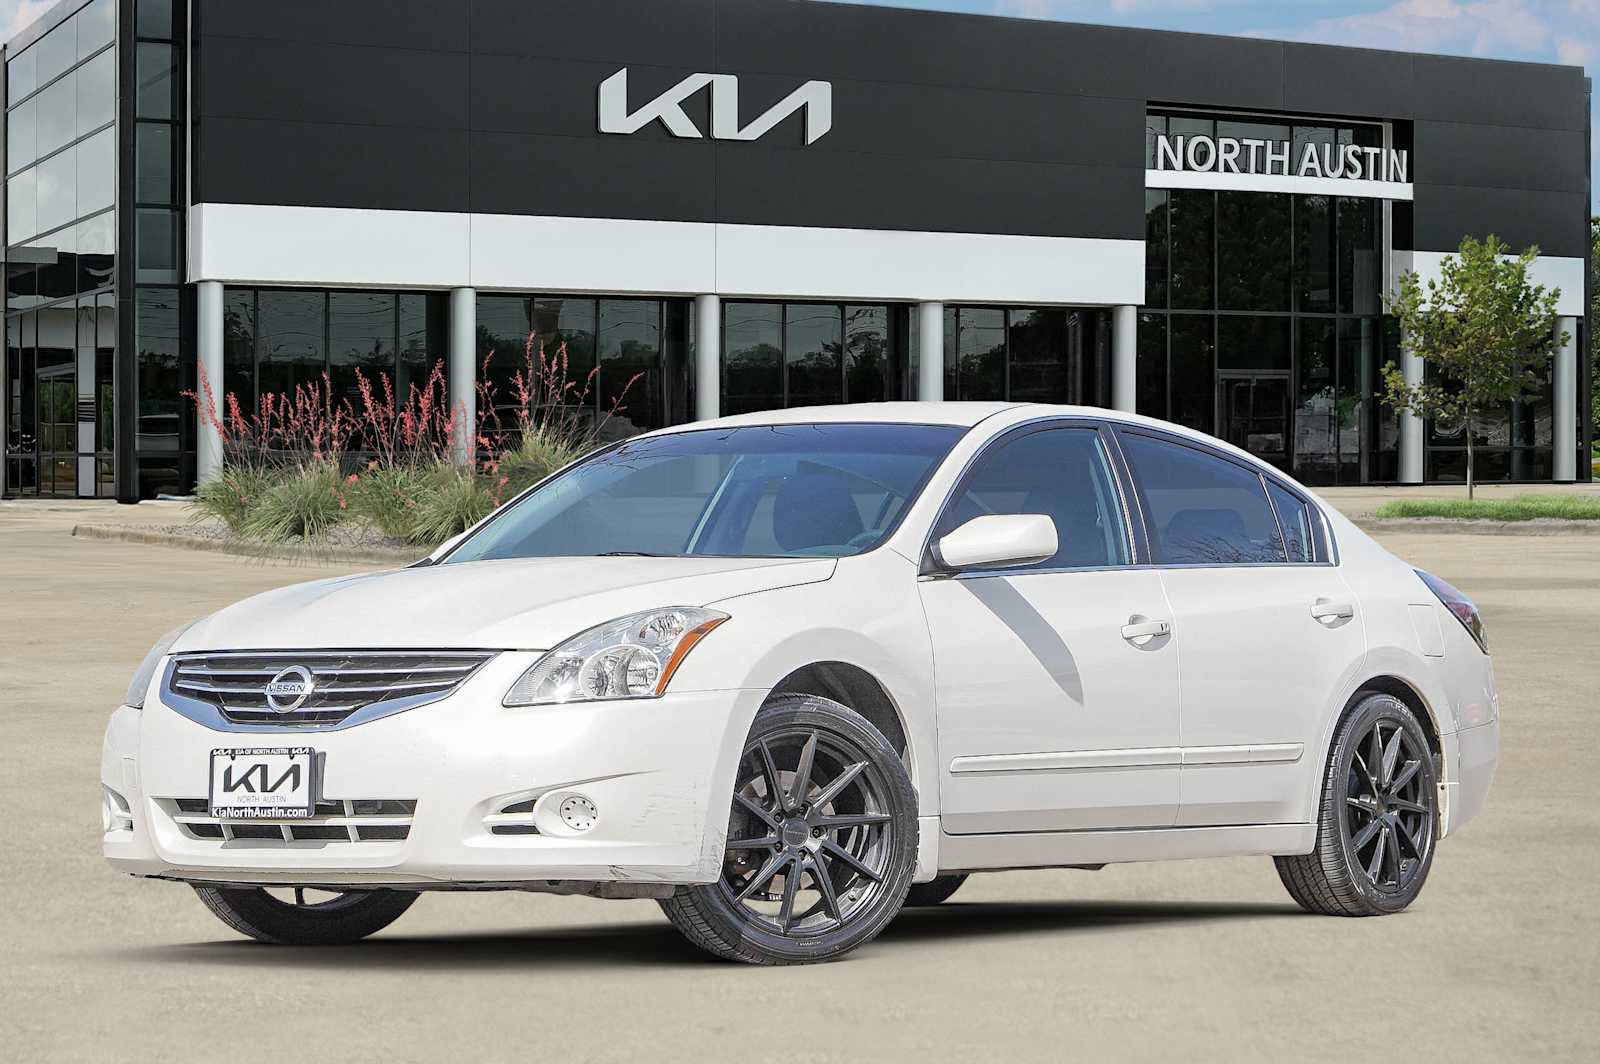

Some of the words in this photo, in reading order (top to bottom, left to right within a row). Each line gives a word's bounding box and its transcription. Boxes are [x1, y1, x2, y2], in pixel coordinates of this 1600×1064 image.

[598, 67, 832, 146] KIA
[1157, 134, 1290, 175] NORTH
[1298, 142, 1408, 183] AUSTIN
[265, 683, 305, 694] NISSAN
[223, 763, 301, 792] KIA
[237, 795, 260, 803] NORTH
[262, 795, 287, 803] AUSTIN
[211, 806, 308, 818] KiaNorthAustin.com
